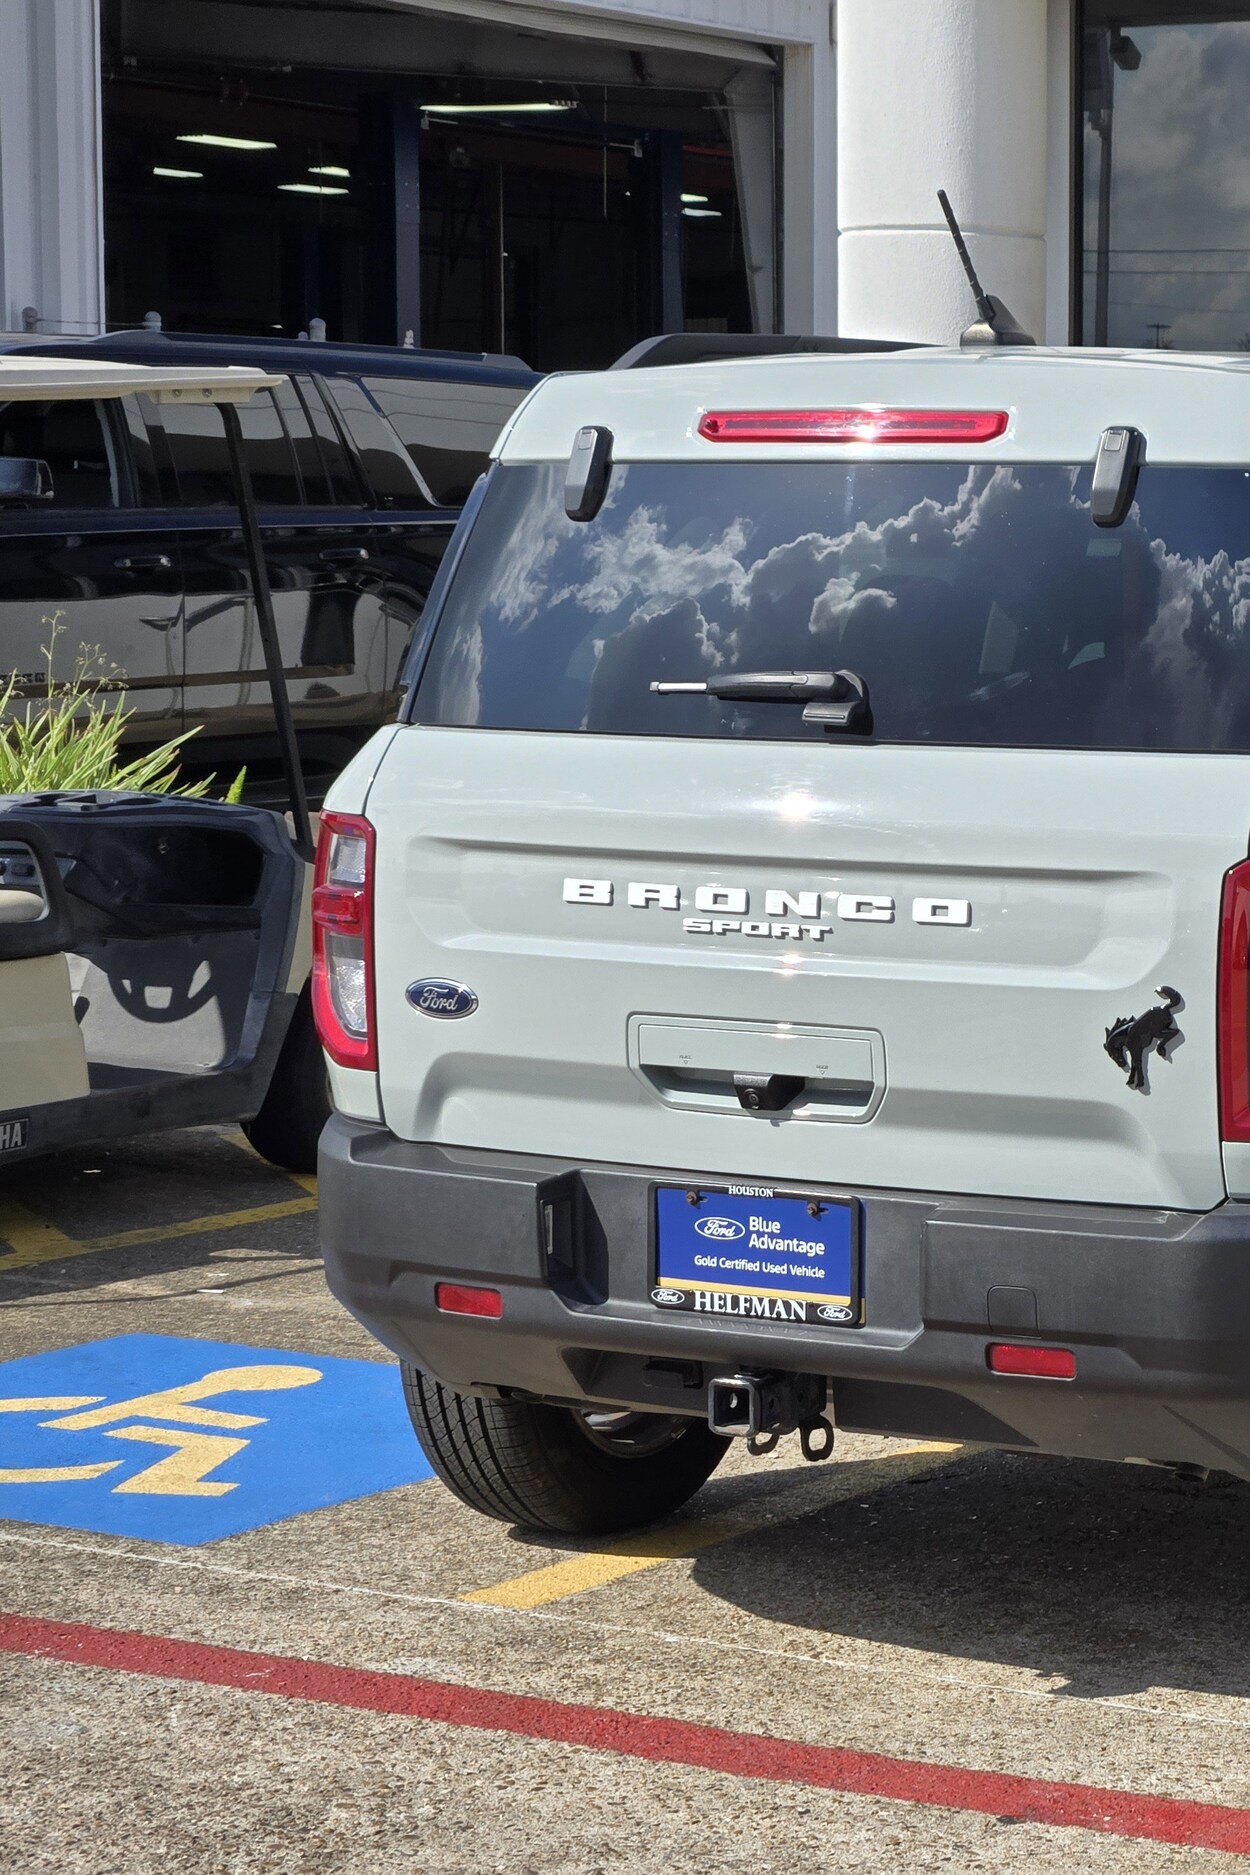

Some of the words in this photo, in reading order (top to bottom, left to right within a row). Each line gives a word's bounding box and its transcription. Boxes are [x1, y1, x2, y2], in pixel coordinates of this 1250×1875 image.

[563, 877, 972, 926] BRONCO
[682, 917, 833, 940] SPORT
[419, 985, 459, 1011] Ford
[728, 1185, 774, 1198] HOUSTON
[702, 1219, 736, 1239] Ford
[749, 1216, 781, 1234] Blue
[749, 1233, 825, 1257] Advantage
[694, 1254, 717, 1268] Gold
[719, 1256, 760, 1272] Certified
[762, 1261, 787, 1275] Used
[789, 1264, 825, 1279] Vehicle
[656, 1289, 680, 1303] Ford
[693, 1289, 807, 1321] HELFMAN
[822, 1305, 847, 1320] Ford
